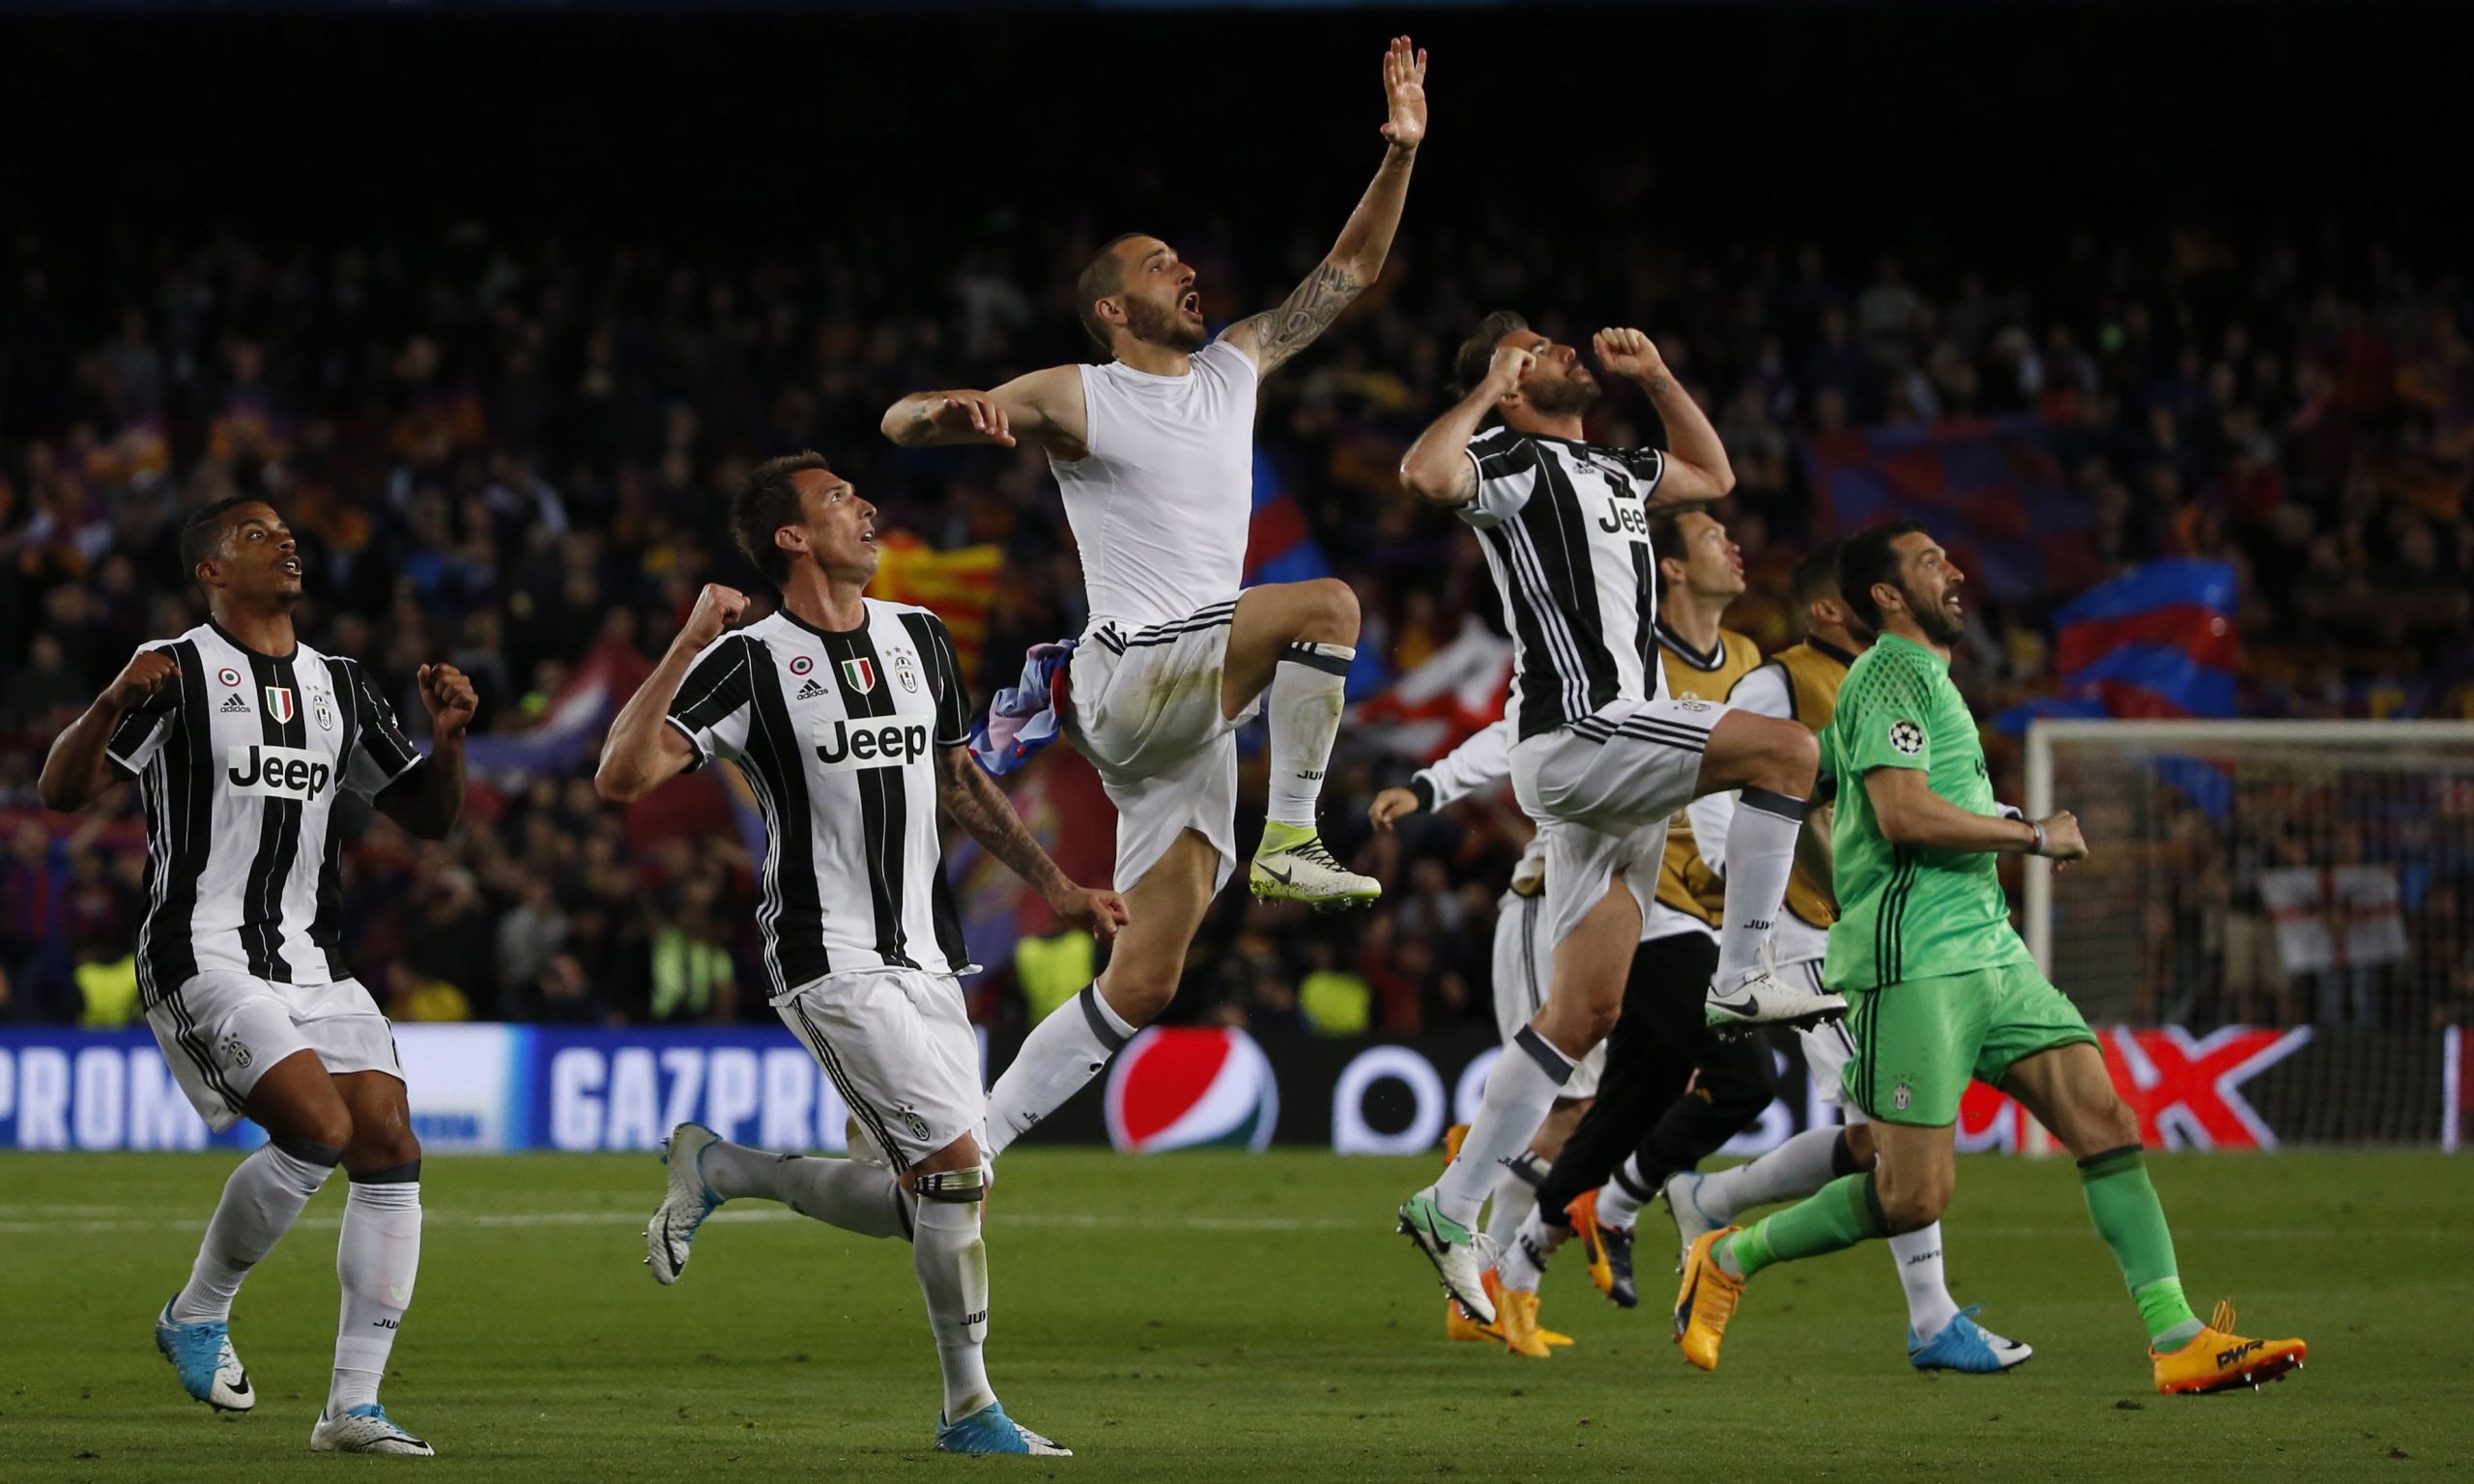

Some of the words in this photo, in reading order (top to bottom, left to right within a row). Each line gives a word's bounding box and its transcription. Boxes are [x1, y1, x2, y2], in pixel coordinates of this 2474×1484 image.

[1598, 498, 1647, 535] Jee
[796, 687, 829, 700] adidas
[816, 720, 927, 764] Jeep
[228, 745, 330, 801] Jeep
[551, 1047, 854, 1151] GAZPR
